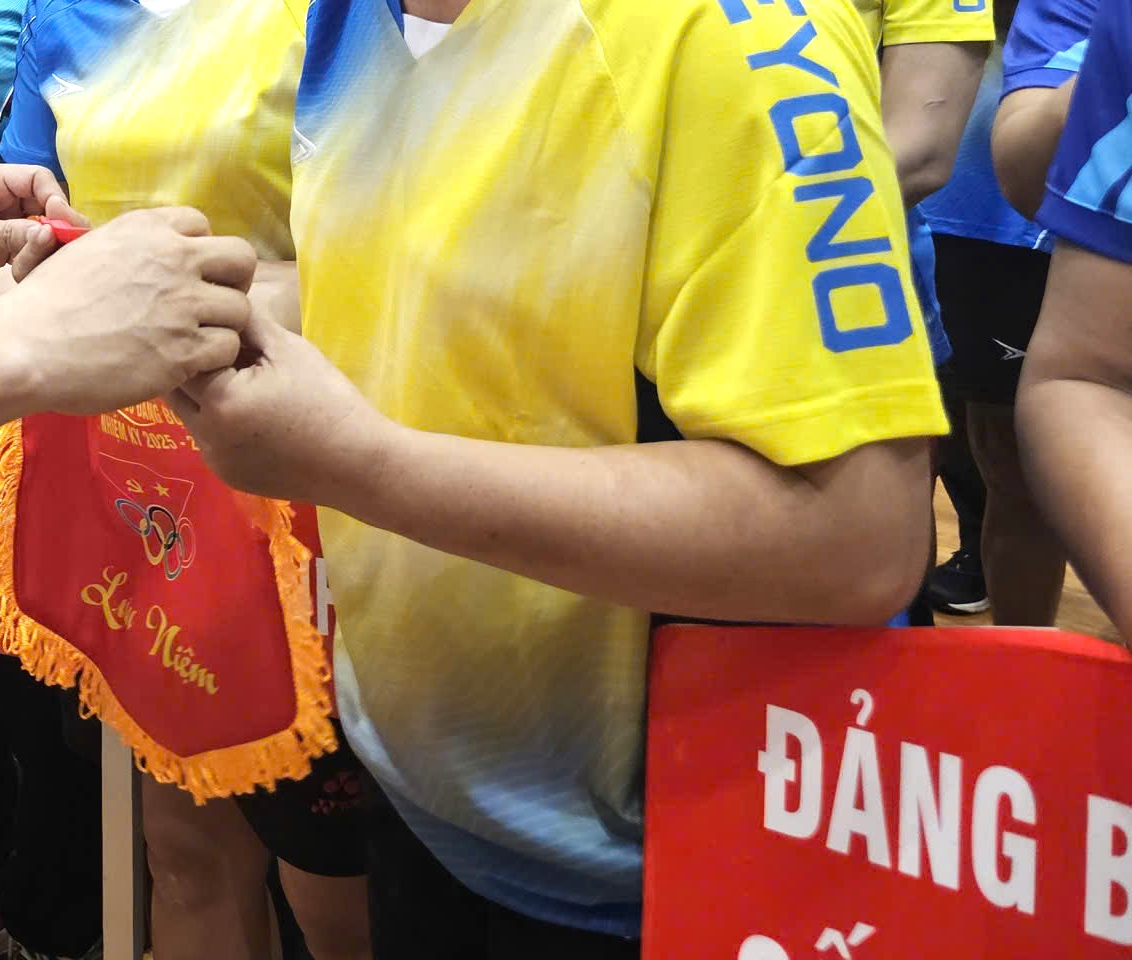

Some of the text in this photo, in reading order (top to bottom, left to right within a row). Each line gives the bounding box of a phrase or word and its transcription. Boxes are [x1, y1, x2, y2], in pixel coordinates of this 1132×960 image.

[142, 430, 178, 450] 2025
[145, 604, 220, 696] Niệm
[757, 688, 1037, 916] ĐẢNG
